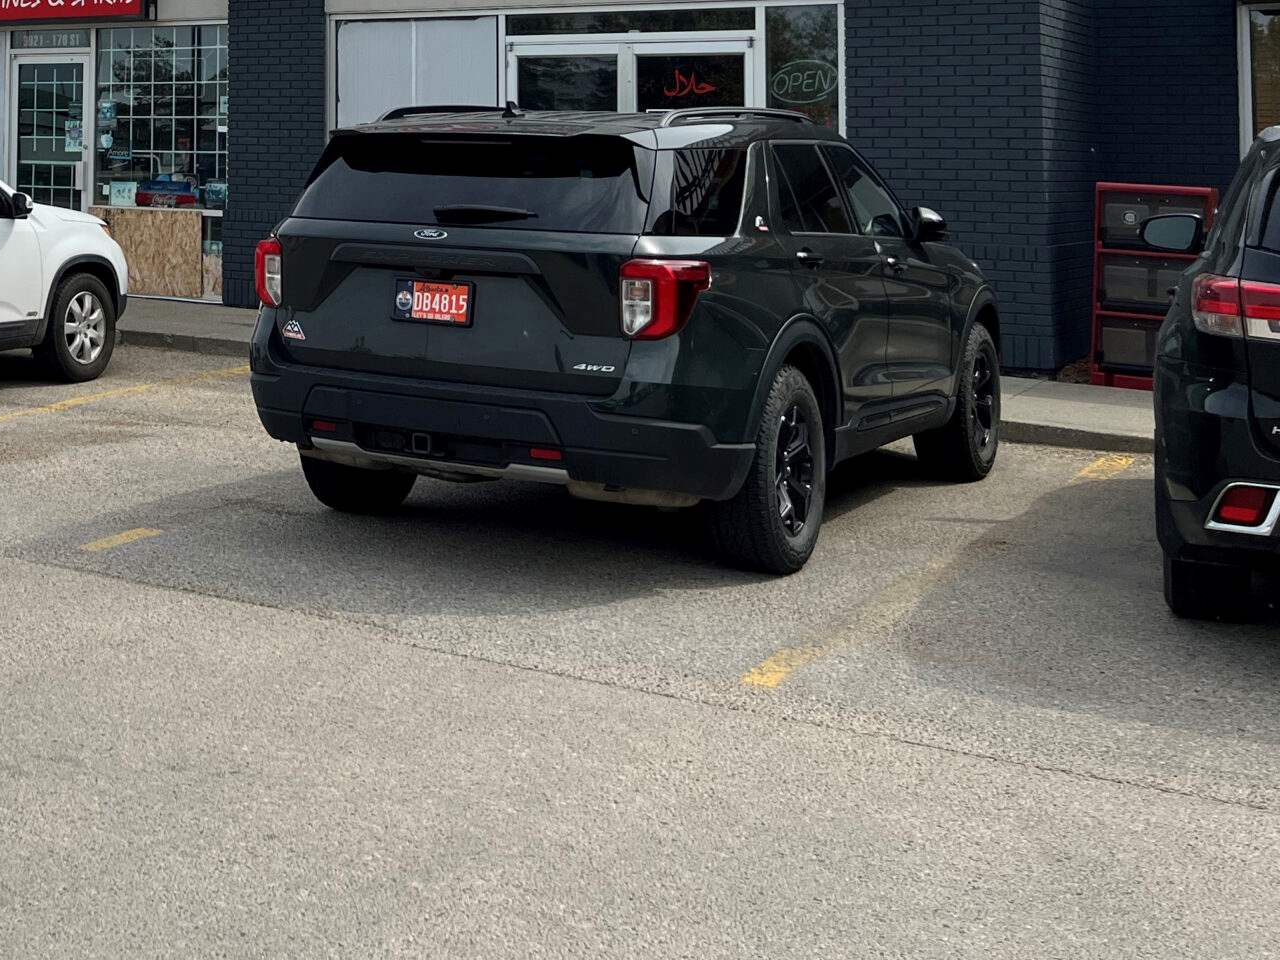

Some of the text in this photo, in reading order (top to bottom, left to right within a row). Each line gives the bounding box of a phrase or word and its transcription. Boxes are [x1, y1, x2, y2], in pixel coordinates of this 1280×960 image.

[663, 69, 716, 97] حلال
[773, 70, 831, 95] OPEN
[414, 292, 469, 314] DB4815
[573, 363, 615, 372] 4WD
